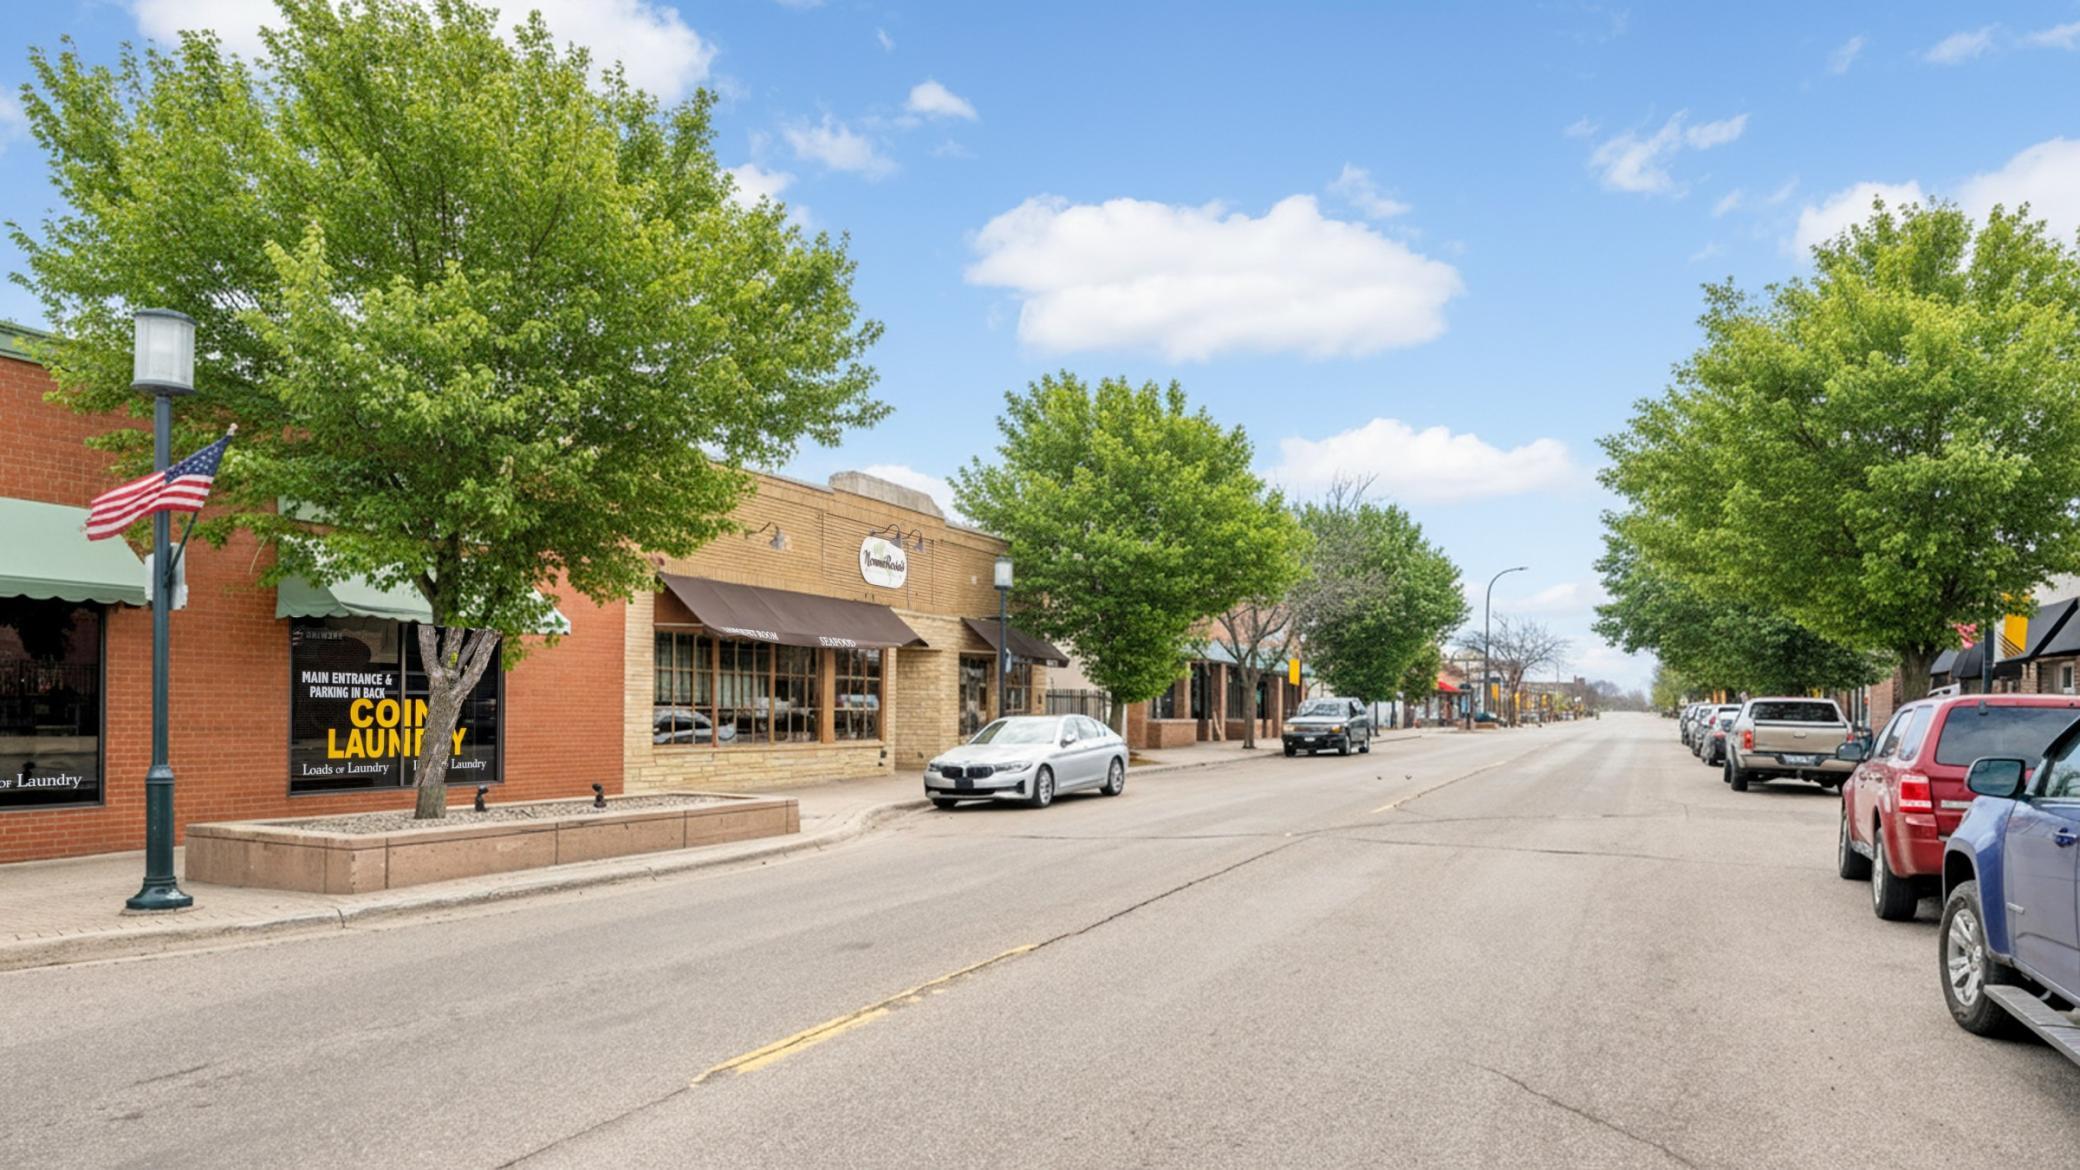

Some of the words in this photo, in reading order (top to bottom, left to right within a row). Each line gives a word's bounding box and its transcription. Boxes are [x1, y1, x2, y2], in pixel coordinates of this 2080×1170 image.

[818, 636, 857, 648] SEAFOOD
[302, 670, 329, 683] MAIN
[332, 671, 383, 685] ENTRANCE
[385, 674, 392, 685] &
[309, 686, 348, 698] PARKING
[351, 687, 361, 698] IN
[363, 688, 385, 699] BACK
[350, 698, 430, 728] COIN
[327, 728, 467, 759] LAUNY
[302, 763, 333, 776] Loads
[347, 762, 390, 775] Laundry
[451, 758, 487, 771] Laundry
[16, 773, 82, 789] Laundry
